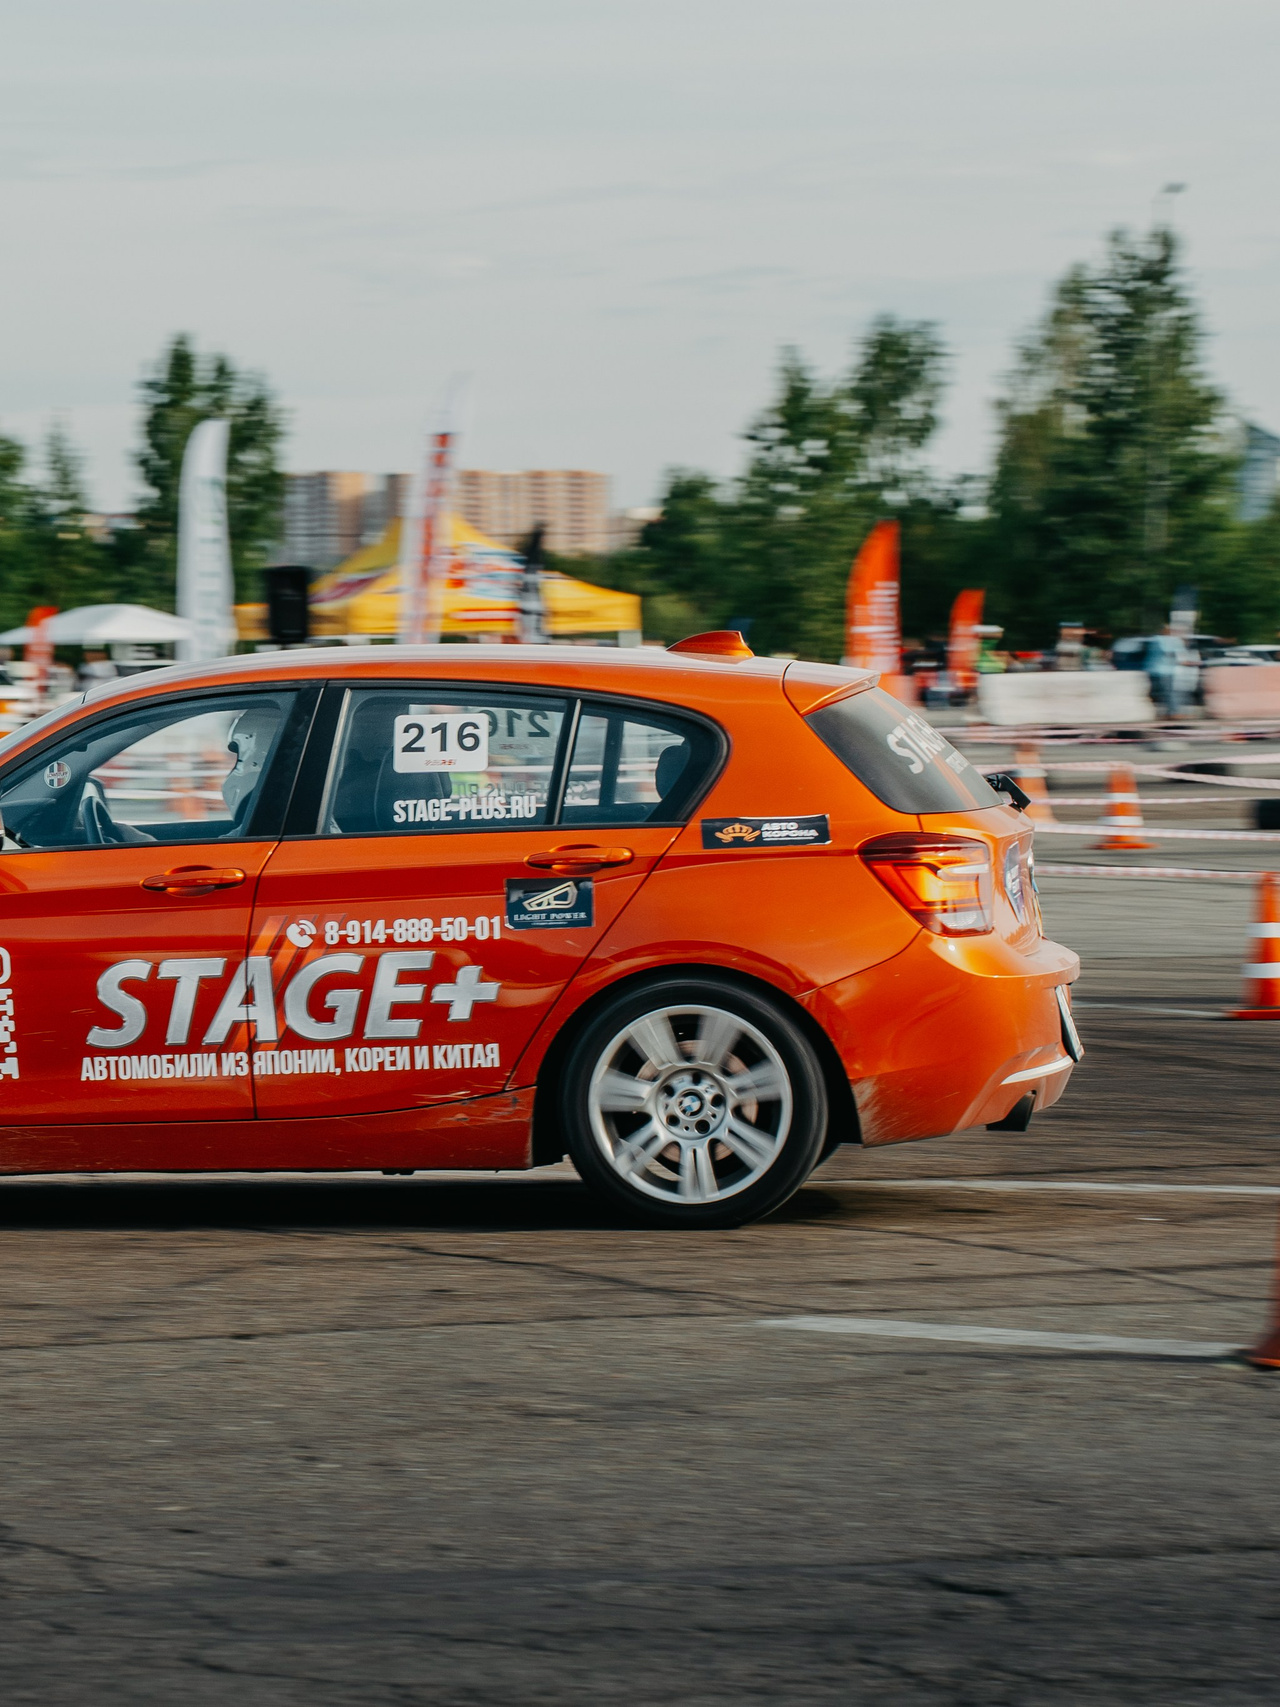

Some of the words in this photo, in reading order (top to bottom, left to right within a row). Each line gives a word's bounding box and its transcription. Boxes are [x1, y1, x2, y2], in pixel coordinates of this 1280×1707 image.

[401, 721, 480, 753] 216
[393, 795, 537, 823] STAGE-PLUS.RU
[324, 915, 501, 945] 8-914-888-50-01
[86, 951, 501, 1048] STAGE+
[80, 1053, 218, 1081] АВТОМОБИЛИ
[221, 1051, 249, 1077] ИЗ
[252, 1048, 342, 1076] ЯПОНИИ,
[344, 1045, 411, 1072] КОРЕИ
[414, 1045, 429, 1070] И
[432, 1043, 500, 1069] КИТАЯ
